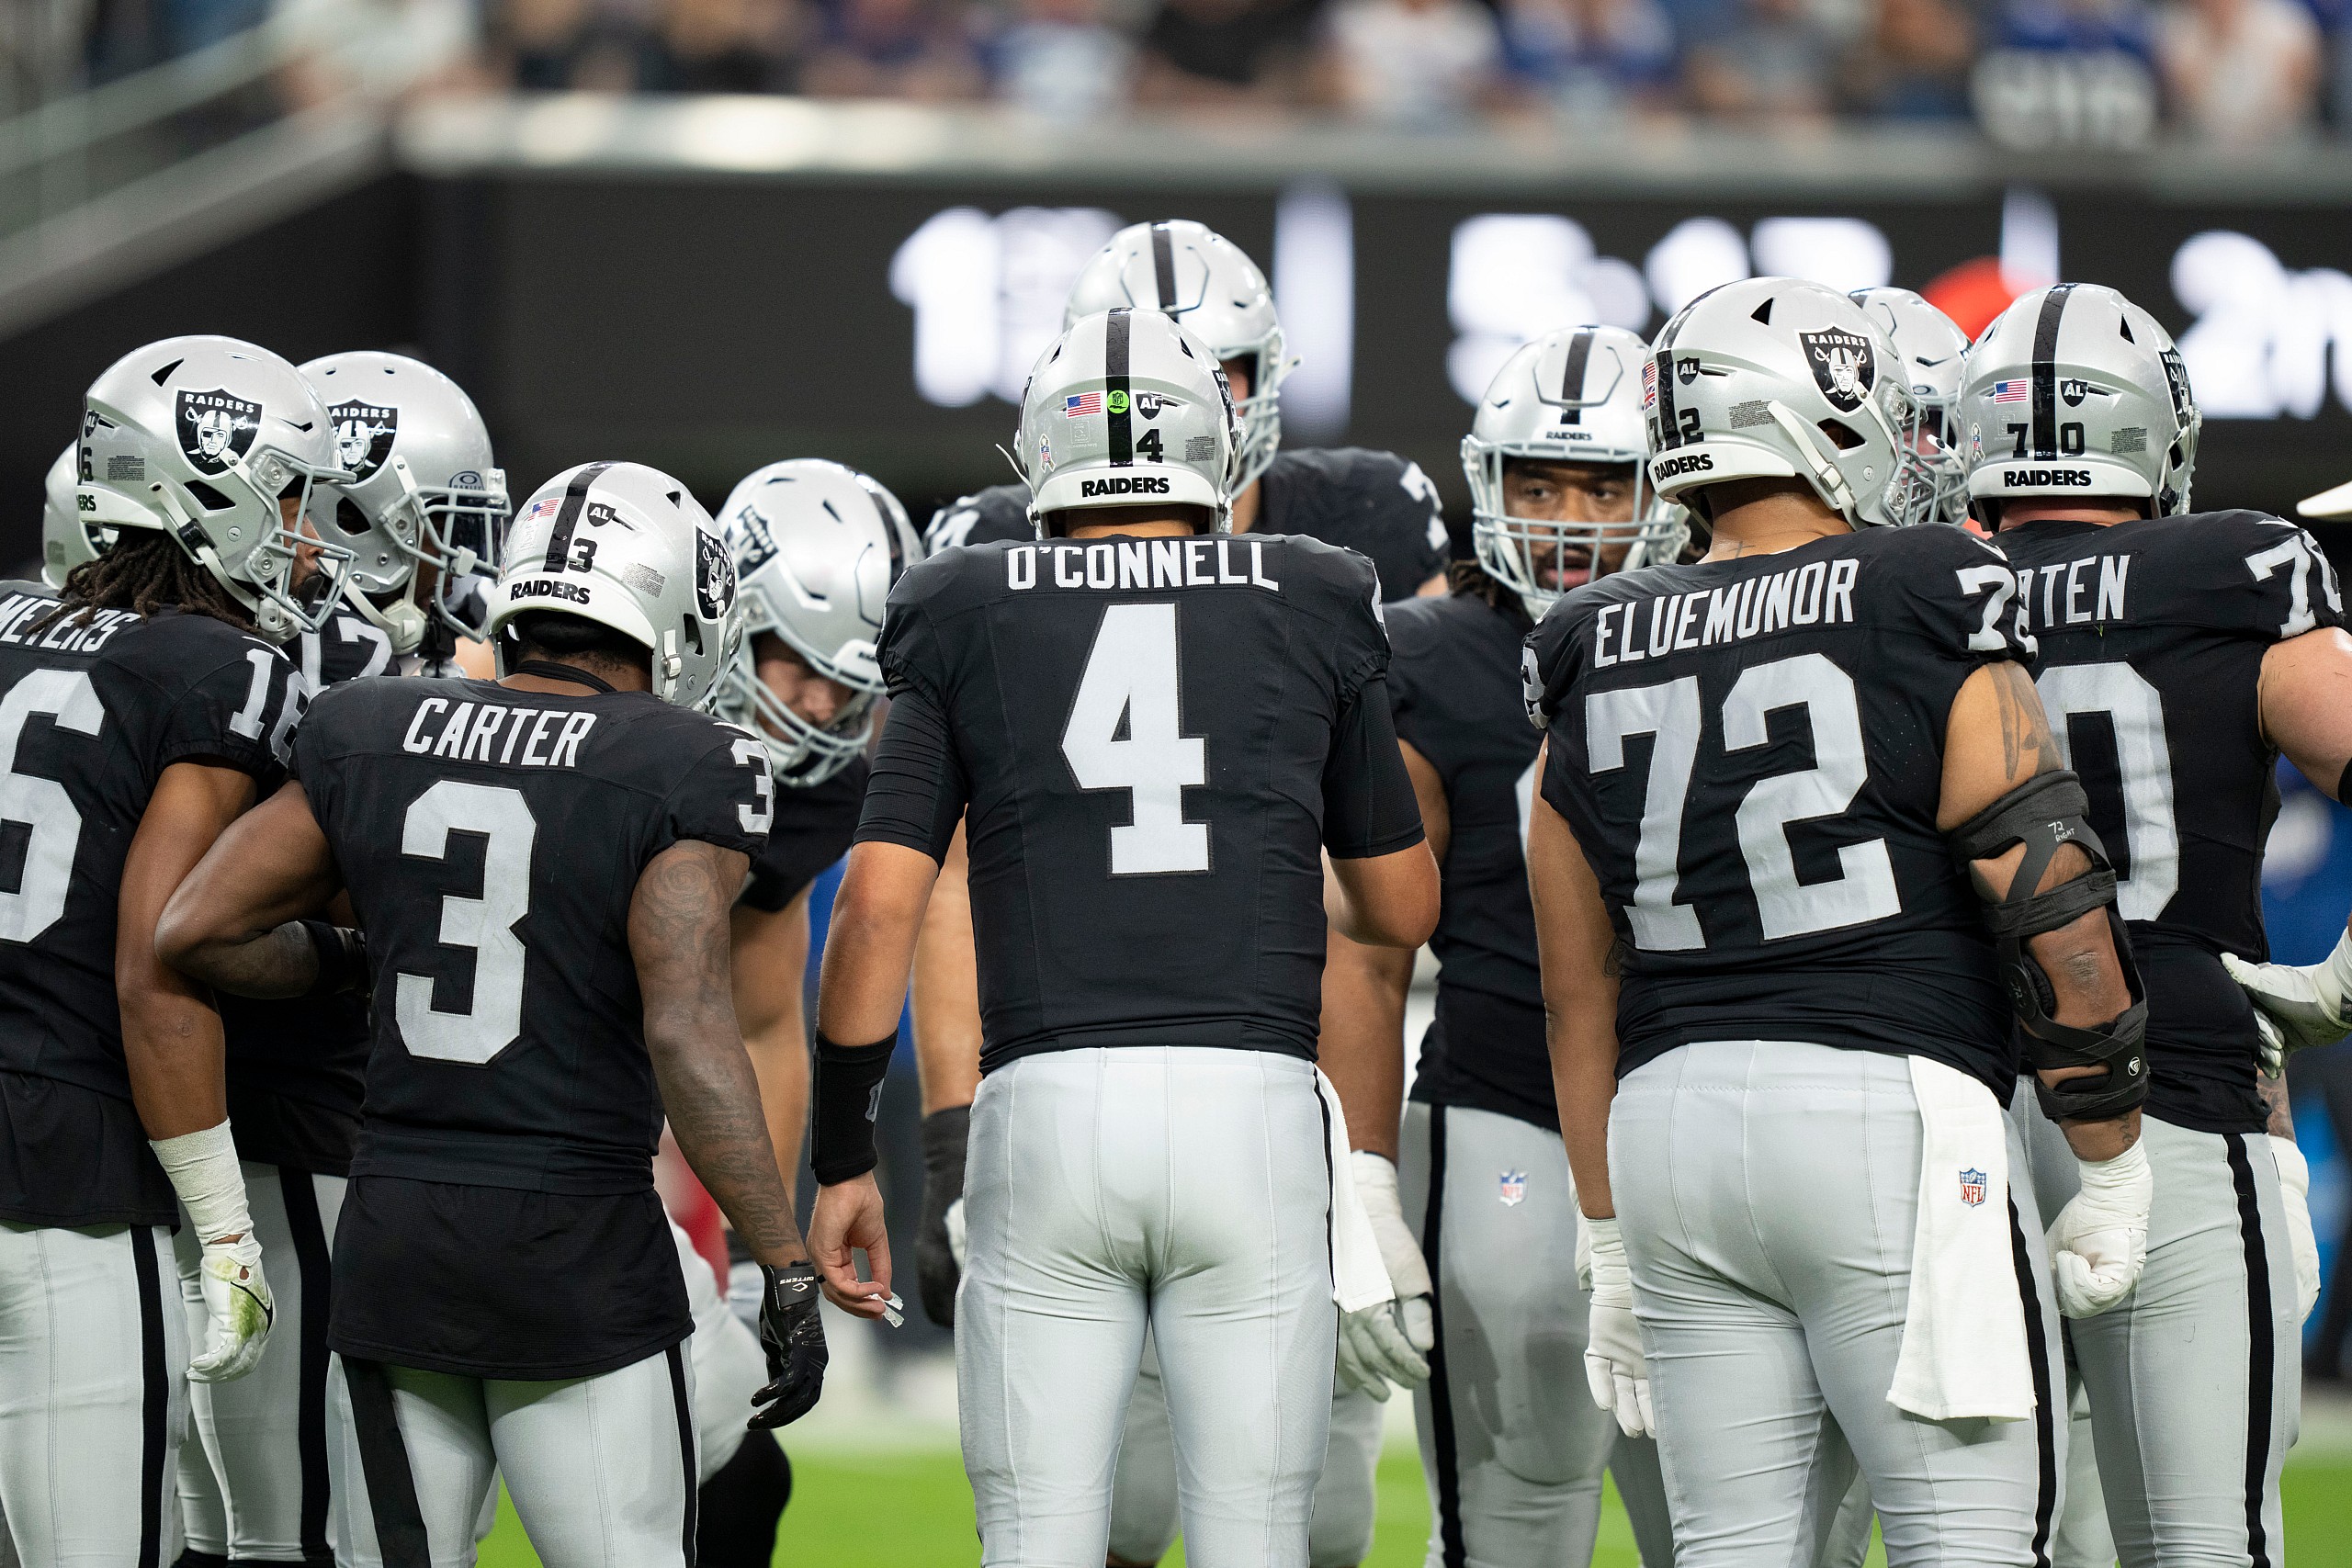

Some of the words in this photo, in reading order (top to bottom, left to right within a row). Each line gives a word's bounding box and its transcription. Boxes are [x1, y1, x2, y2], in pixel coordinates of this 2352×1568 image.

[1808, 333, 1867, 348] RAIDERS
[1679, 362, 1697, 376] AL
[2064, 383, 2084, 397] AL
[185, 392, 255, 413] RAIDERS
[1139, 397, 1159, 410] AL
[1136, 428, 1164, 463] 4
[1545, 431, 1593, 442] RAIDERS
[1654, 454, 1714, 483] RAIDERS
[2004, 469, 2092, 488] RAIDERS
[1081, 477, 1170, 498] RAIDERS
[589, 506, 610, 521] AL
[567, 537, 598, 574] 3
[1007, 539, 1279, 592] O'CONNELL
[510, 580, 591, 605] RAIDERS
[1594, 558, 1860, 669] ELUEMUNOR
[402, 697, 597, 768] CARTER
[1061, 603, 1210, 874] 4
[730, 739, 775, 835] 3
[1585, 653, 1903, 952] 72
[2047, 820, 2065, 835] 72
[2054, 828, 2075, 843] RIGHT
[395, 779, 537, 1065] 3
[1962, 1184, 1984, 1204] NFL
[779, 1275, 815, 1285] CUTTERS
